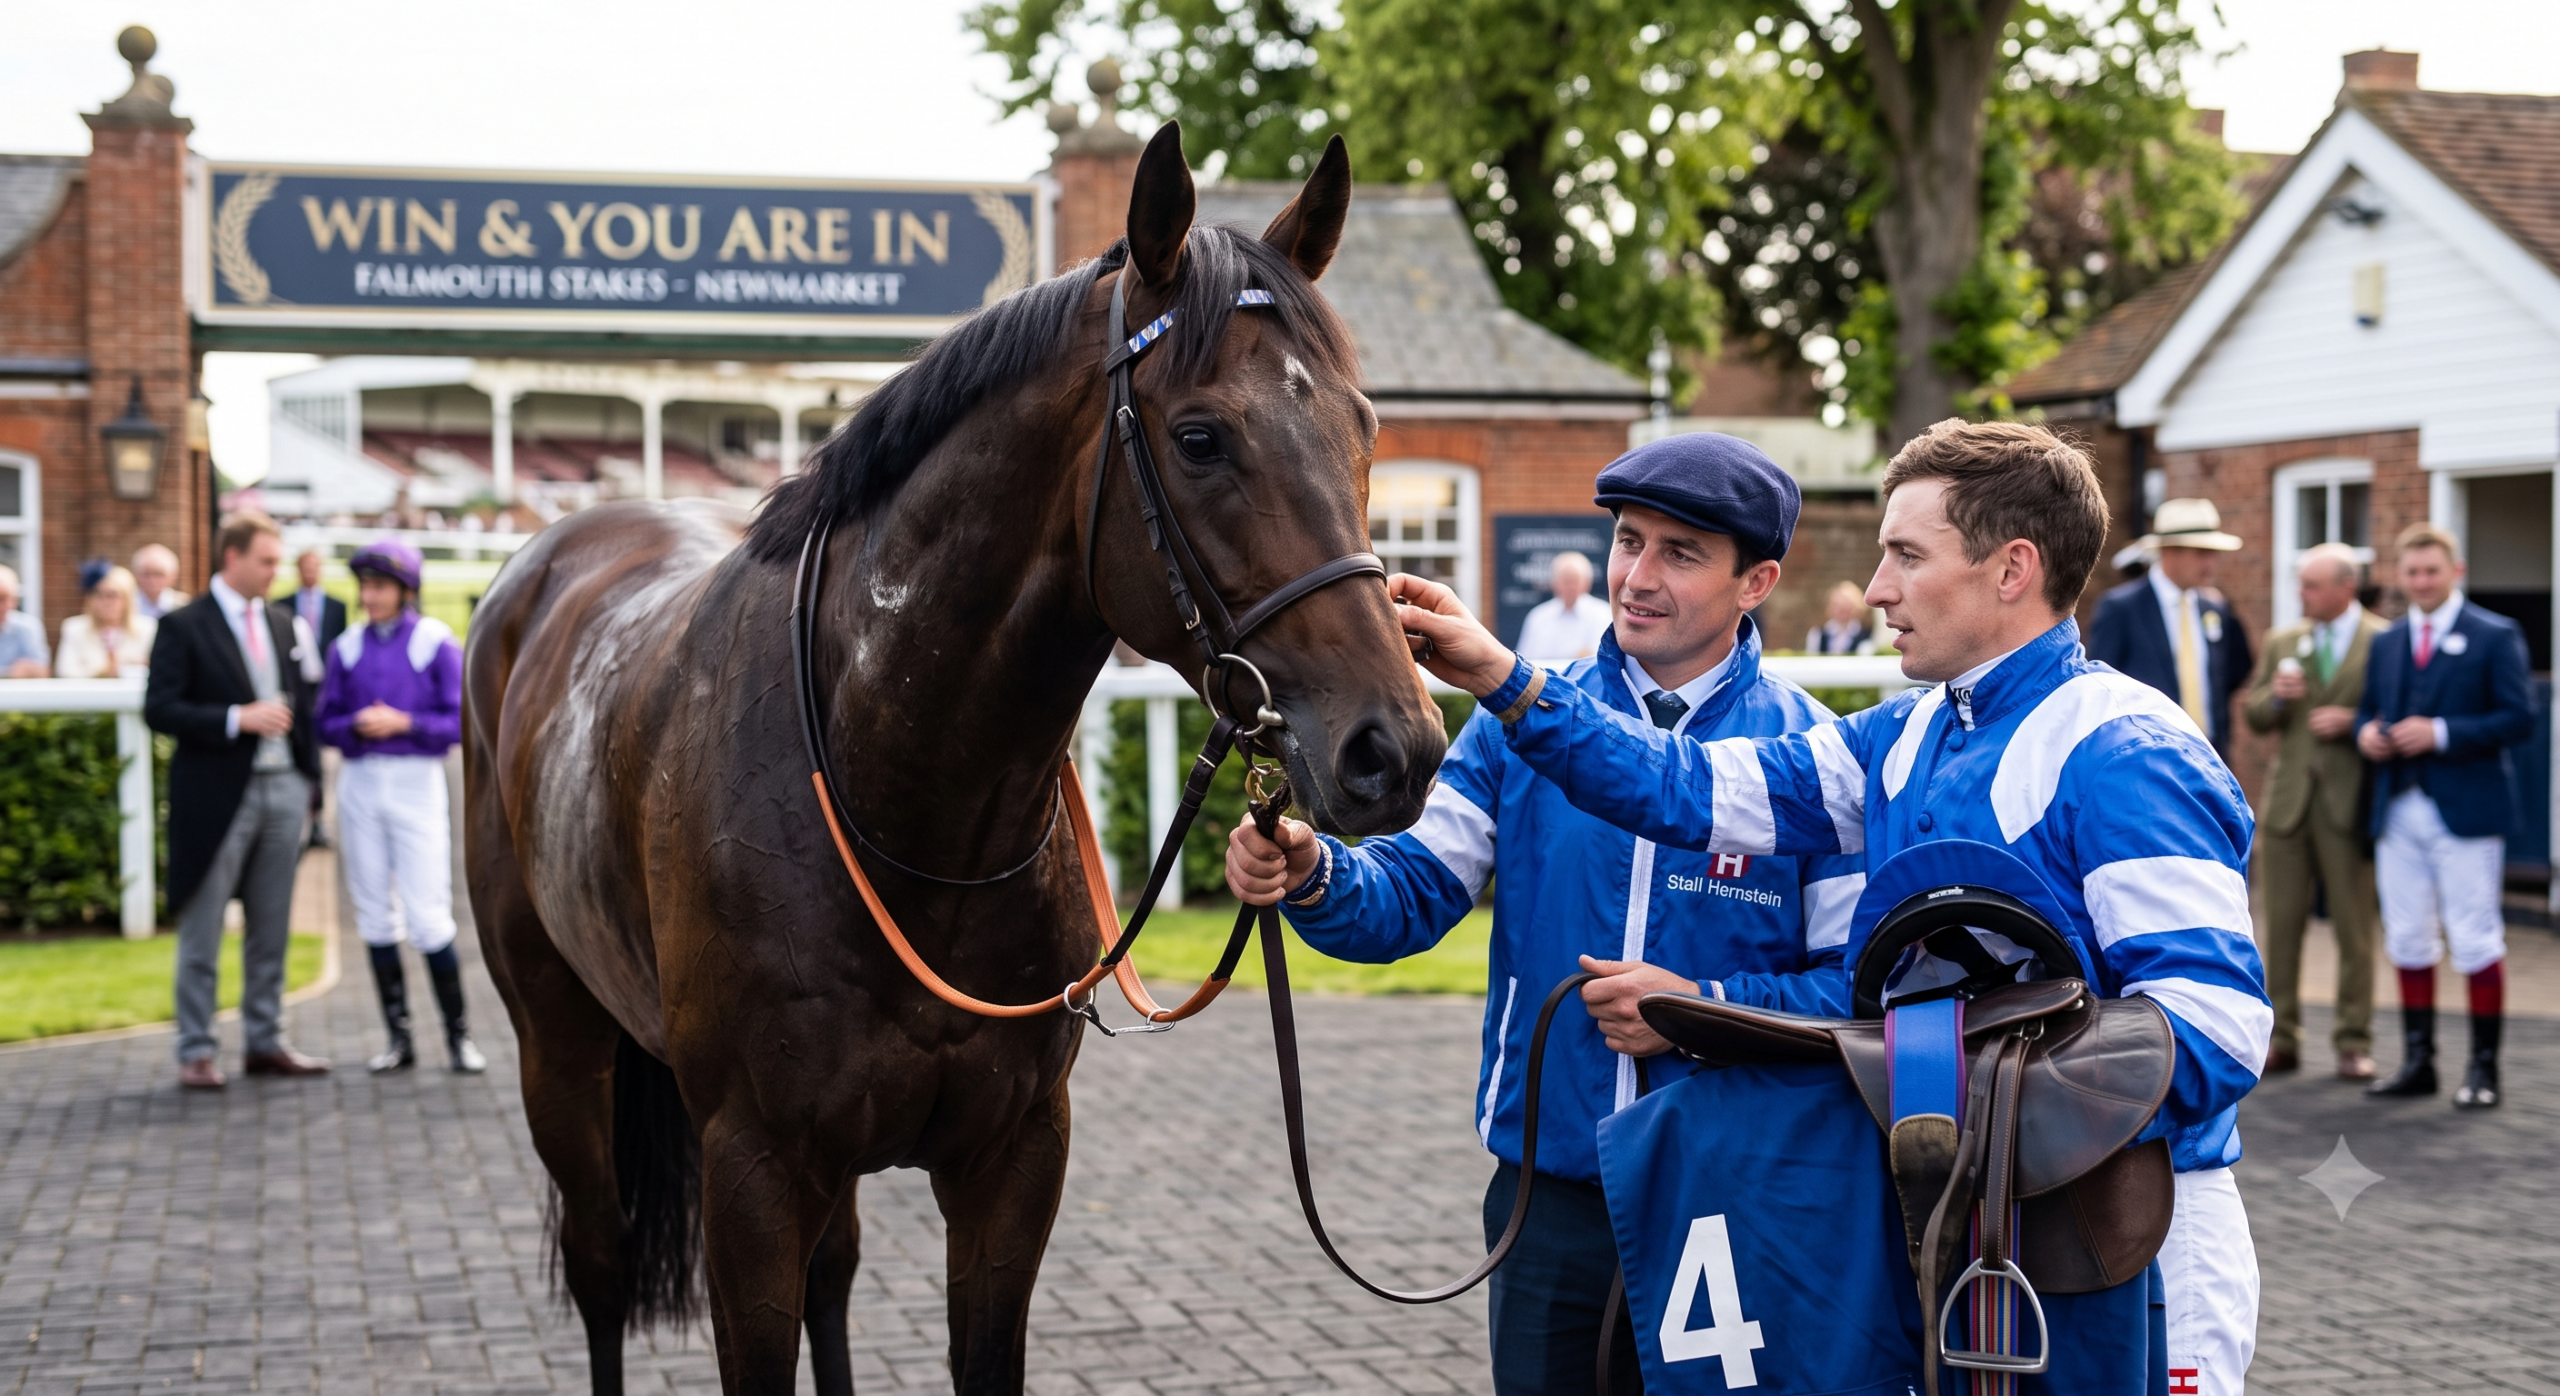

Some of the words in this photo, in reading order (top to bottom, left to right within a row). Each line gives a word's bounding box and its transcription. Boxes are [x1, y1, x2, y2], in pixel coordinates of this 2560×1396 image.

[302, 197, 457, 254] WIN
[478, 199, 539, 258] &
[547, 201, 702, 262] YOU
[718, 206, 851, 264] ARE
[872, 208, 949, 266] IN
[355, 262, 544, 299] FALMOUTH
[549, 266, 669, 303] STAKES
[695, 268, 906, 306] NEWMARKET
[1716, 853, 1744, 877] H
[1667, 874, 1703, 893] Stall
[1708, 879, 1781, 907] Hernstein
[1659, 1213, 1765, 1390] 4
